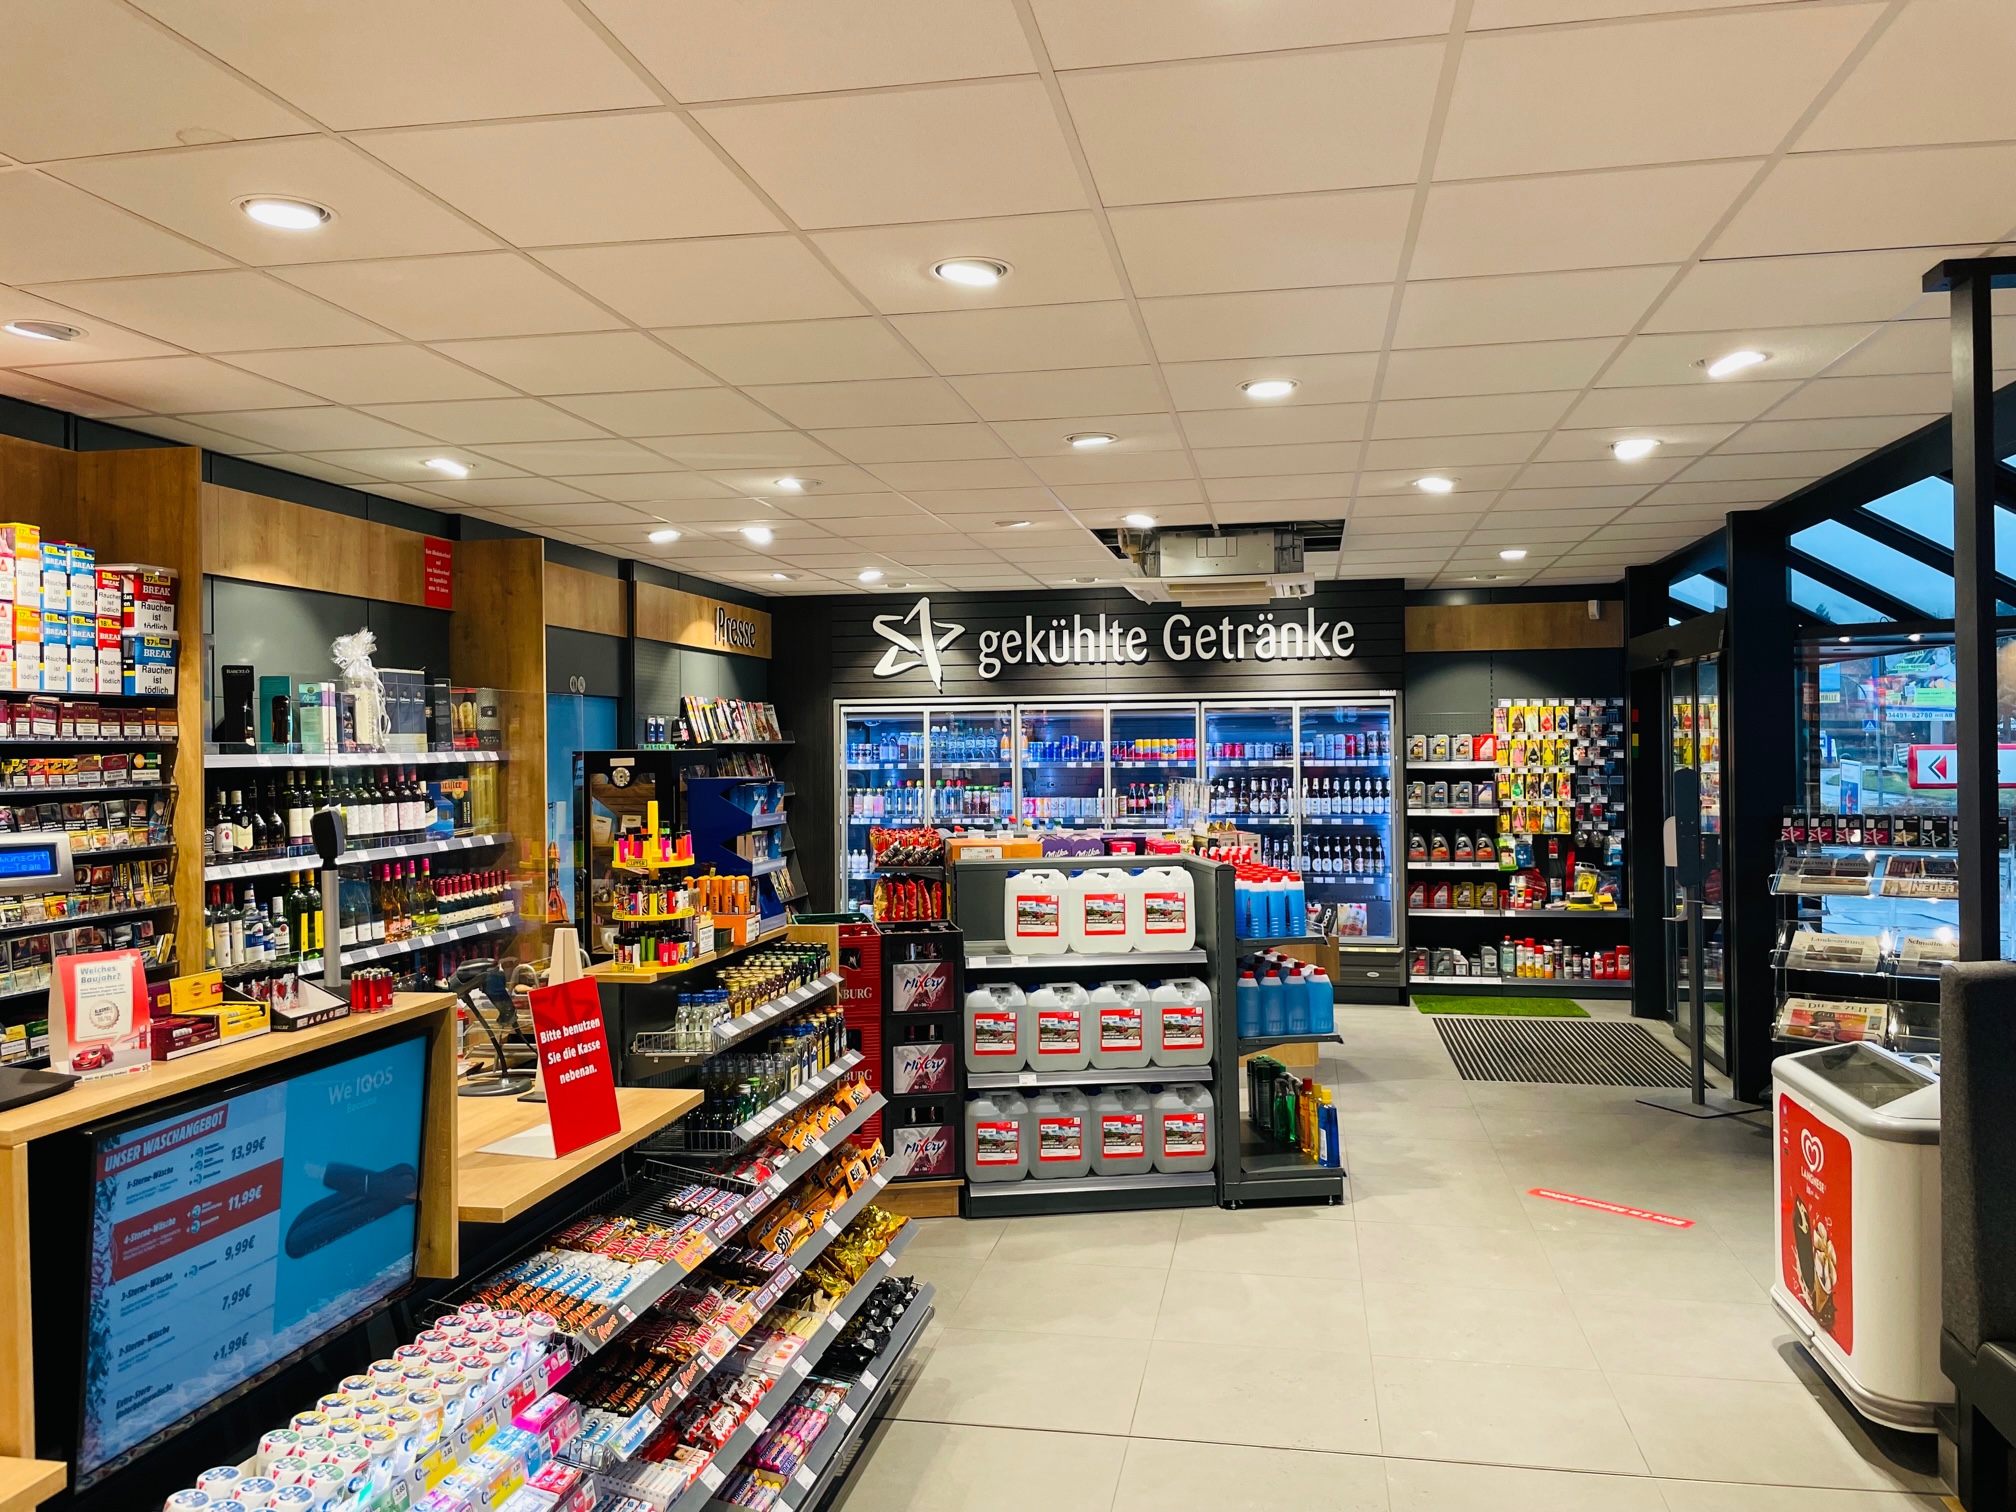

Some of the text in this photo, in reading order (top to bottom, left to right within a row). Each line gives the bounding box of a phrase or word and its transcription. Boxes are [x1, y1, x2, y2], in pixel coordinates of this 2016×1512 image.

[143, 585, 171, 596] BREAK
[141, 601, 172, 613] Rauchen
[716, 606, 757, 649] Presse
[144, 648, 172, 659] BREAK
[978, 607, 1355, 679] gekühlte Getränke
[142, 665, 173, 676] Rauchen
[153, 676, 162, 684] ist
[144, 686, 169, 694] tödlich
[1045, 848, 1069, 857] Milka
[1075, 848, 1100, 857] Milka
[1890, 860, 1914, 874] Bild
[1912, 884, 1955, 893] NEUER
[80, 966, 116, 975] Welches
[81, 972, 121, 984] Baujahr?
[1844, 1006, 1870, 1014] ZEIT
[540, 1018, 601, 1044] Bitte benutzen
[548, 1040, 601, 1065] Sie die Kasse
[559, 1064, 598, 1084] nebenan.
[328, 1066, 394, 1105] We IQOS
[104, 1110, 225, 1172] UNSER WASCHANGEBOT
[126, 1166, 174, 1190] 5-Sterne-Wäsche
[231, 1136, 267, 1162] 13,99€
[1800, 1166, 1826, 1193] LANGNESE
[124, 1216, 176, 1245] 4-Sterne-Wäsche
[228, 1185, 263, 1212] 11,99€
[588, 1224, 614, 1246] TWIX
[622, 1236, 651, 1256] TWIX
[225, 1235, 256, 1261] 9,99€
[642, 1238, 670, 1258] TWIX
[662, 1240, 690, 1260] TWIX
[222, 1284, 252, 1310] 7,99€
[691, 1293, 720, 1316] TWIX
[712, 1304, 738, 1326] TWIX
[597, 1314, 619, 1342] Mars
[213, 1332, 249, 1361] +1,99€
[680, 1360, 700, 1389] Mars
[652, 1386, 672, 1418] Mars
